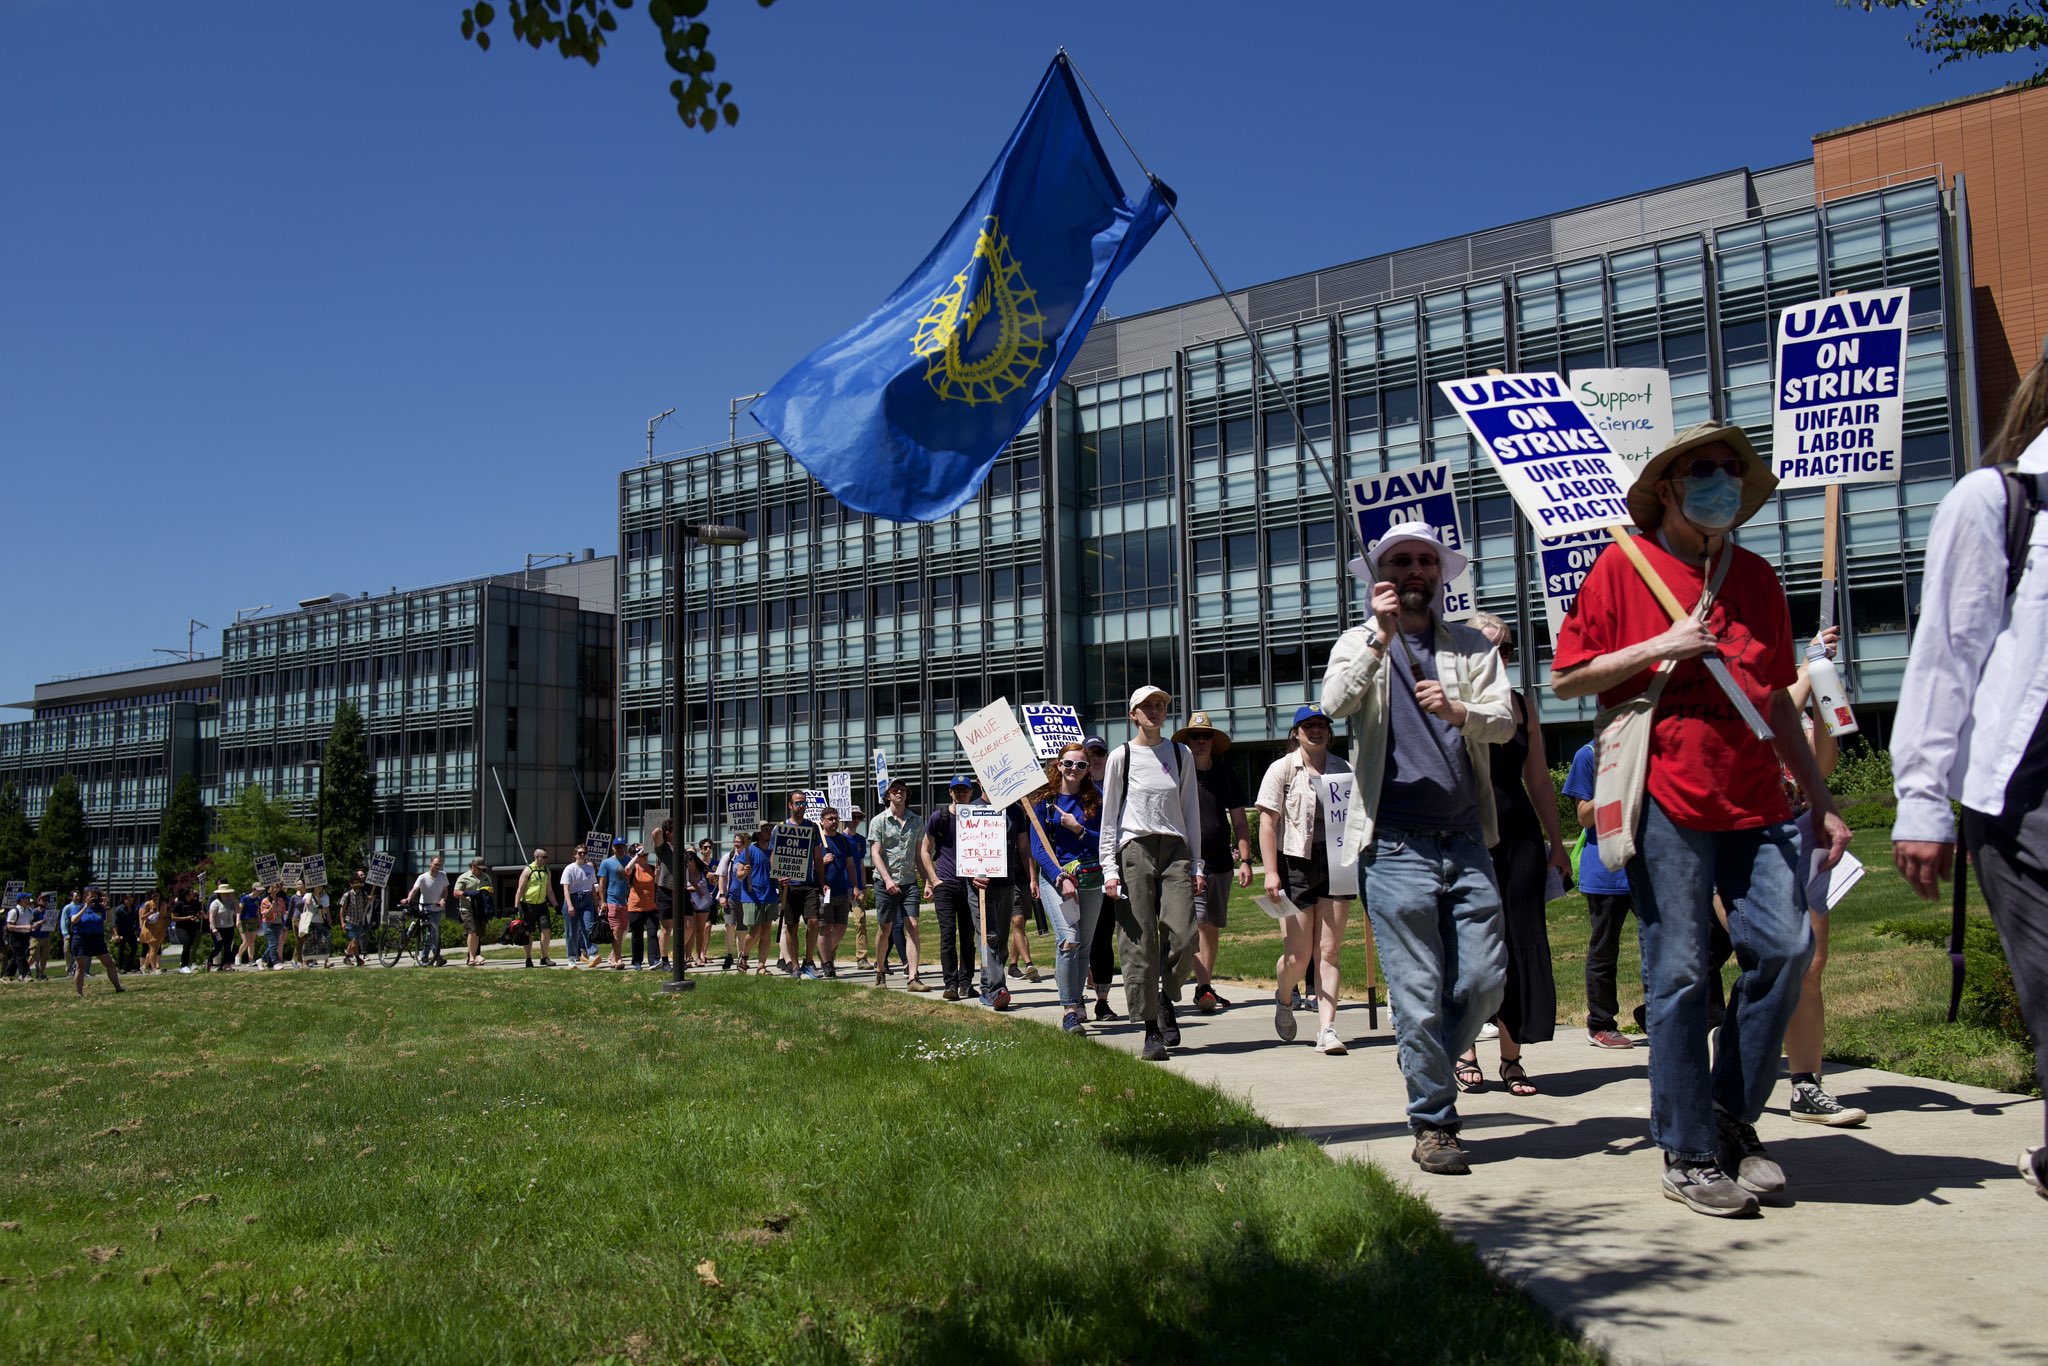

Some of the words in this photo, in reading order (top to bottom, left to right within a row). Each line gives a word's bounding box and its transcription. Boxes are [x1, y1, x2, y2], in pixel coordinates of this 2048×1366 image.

[1785, 296, 1903, 338] UAW
[1816, 338, 1860, 369] ON
[1450, 377, 1561, 406] UAW
[1784, 366, 1895, 403] STRIKE
[1581, 381, 1653, 412] Support
[1507, 406, 1557, 431] ON
[1795, 404, 1879, 432] UNFAIR
[1493, 428, 1605, 459] STRIKE
[1798, 428, 1874, 455] LABOR
[1523, 458, 1612, 483] UNFAIR
[1780, 450, 1894, 479] PRACTICE
[1354, 465, 1447, 506] UAW
[1542, 478, 1623, 503] LABOR
[1389, 503, 1425, 526] ON
[1537, 497, 1628, 526] PRACTI
[1567, 548, 1597, 569] ON
[1549, 571, 1587, 593] STR
[1025, 706, 1072, 715] UAW
[1044, 716, 1063, 724] ON
[966, 717, 1000, 746] VALUE
[1034, 725, 1080, 734] STRIKE
[982, 753, 1013, 779] VALUE
[728, 783, 757, 792] UAW
[832, 773, 849, 786] STOP
[988, 759, 1040, 797] SCIENTISTS!
[729, 801, 758, 811] STRIKE
[737, 794, 749, 802] ON
[732, 811, 756, 819] UNFAIR
[960, 819, 980, 829] UAW
[729, 824, 760, 832] PRACTICE
[778, 826, 811, 837] UAW
[776, 846, 807, 857] STRIKE
[786, 838, 799, 847] ON
[962, 849, 1002, 857] STRIKE
[255, 855, 274, 863] UAW
[303, 855, 322, 863] UAW
[375, 853, 394, 862] UAW
[778, 857, 803, 865] UNFAIR
[773, 869, 805, 879] PRACTICE
